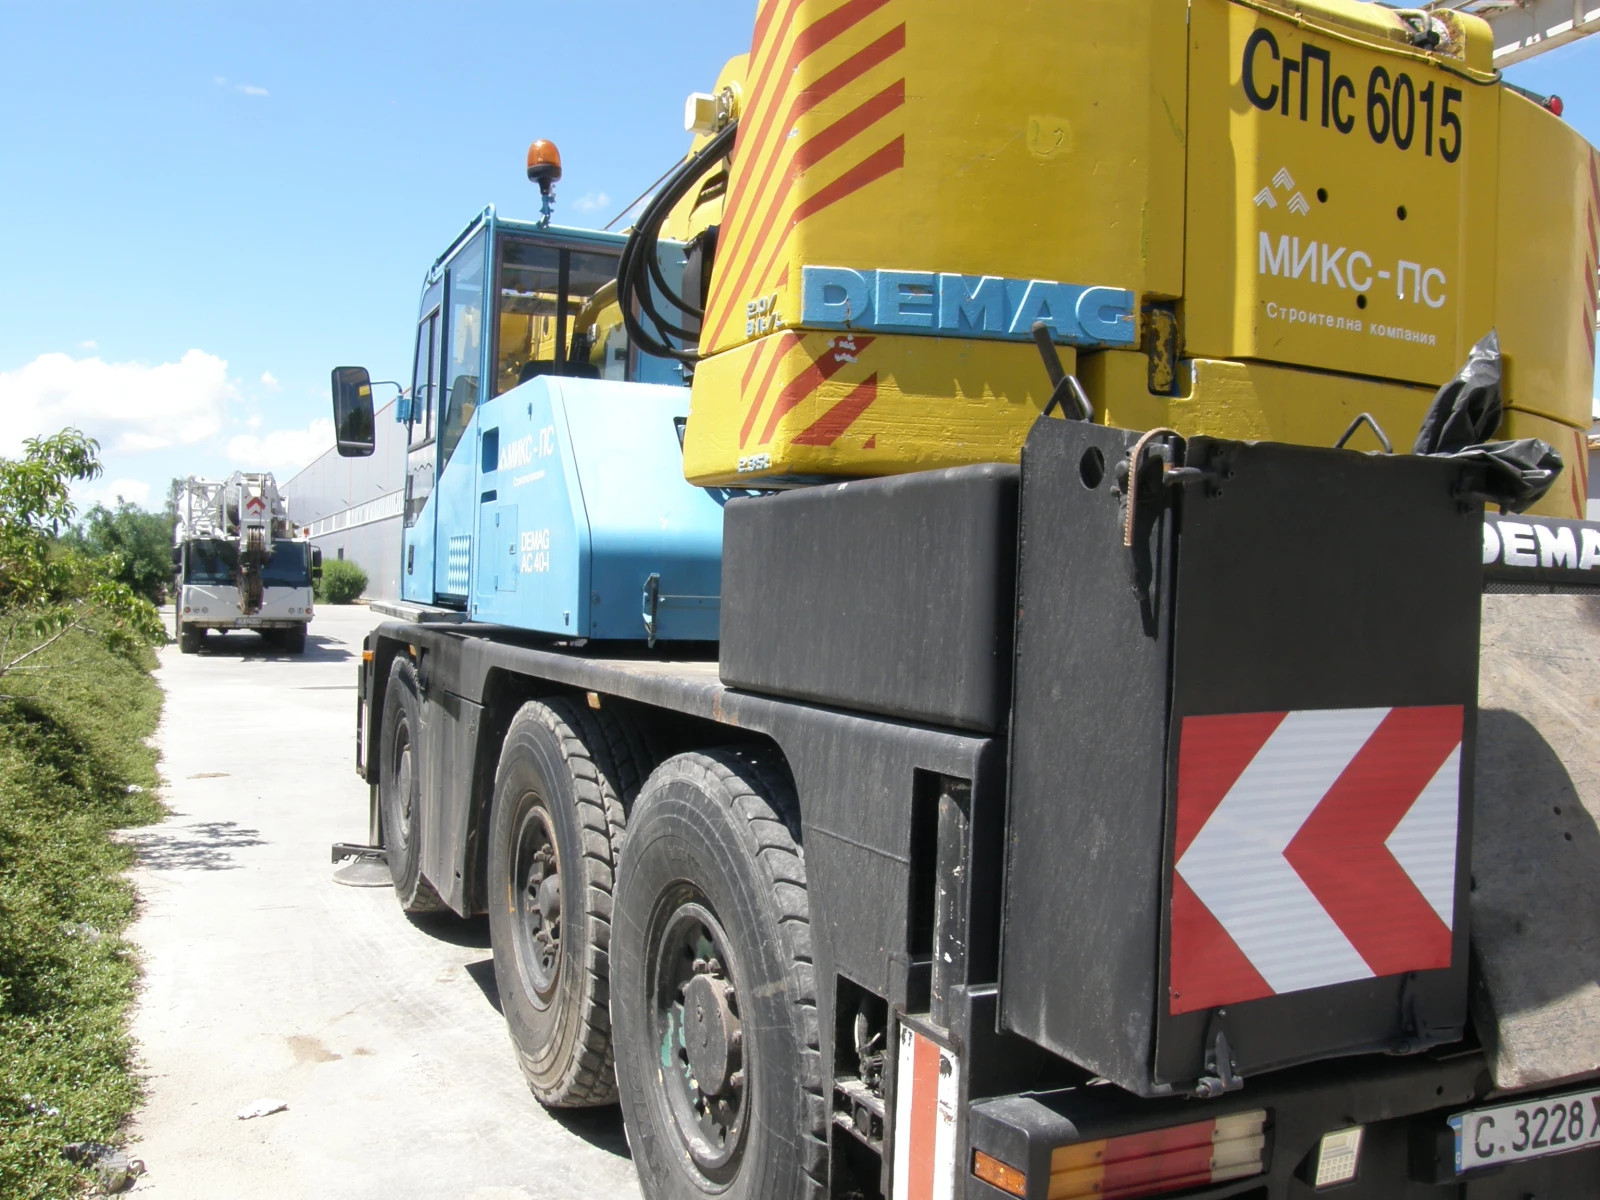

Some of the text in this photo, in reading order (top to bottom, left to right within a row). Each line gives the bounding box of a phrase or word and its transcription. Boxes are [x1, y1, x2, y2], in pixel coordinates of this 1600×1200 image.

[1242, 27, 1462, 163] СгПс 6015
[1258, 231, 1446, 308] МИКС-ПС
[802, 266, 1134, 341] DEMAG
[1266, 301, 1436, 346] Строителна компания
[521, 528, 550, 552] DEMAG
[521, 552, 533, 573] AC
